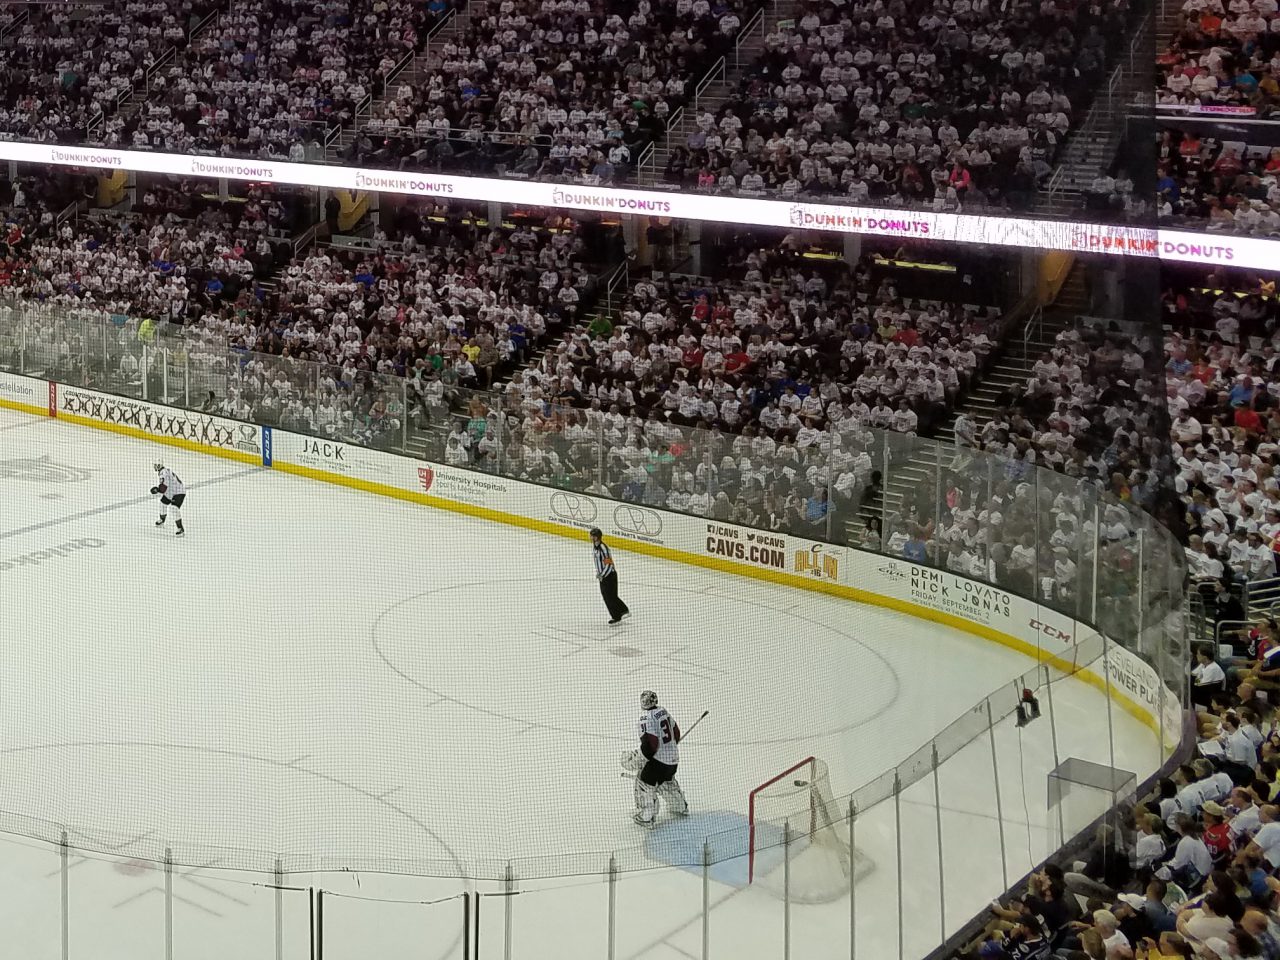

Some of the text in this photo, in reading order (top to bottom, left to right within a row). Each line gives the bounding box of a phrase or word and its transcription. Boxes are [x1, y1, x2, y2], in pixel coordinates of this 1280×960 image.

[237, 167, 273, 178] DONUTS
[409, 181, 453, 193] DONUTS
[618, 198, 671, 212] DONUTS
[867, 217, 930, 234] DONUTS
[1164, 242, 1234, 260] DONUTS
[435, 470, 507, 493] University Hospitals
[436, 481, 455, 491] Sports
[756, 535, 785, 549] @CAVS
[706, 536, 785, 569] CAVS.COM
[794, 549, 839, 580] ALL IN
[911, 566, 944, 584] DEMI
[911, 578, 949, 598] NICK
[911, 589, 938, 603] FRIDAY,
[942, 597, 982, 617] SEPTEMBER
[985, 611, 990, 619] 2
[1029, 618, 1071, 643] CCM
